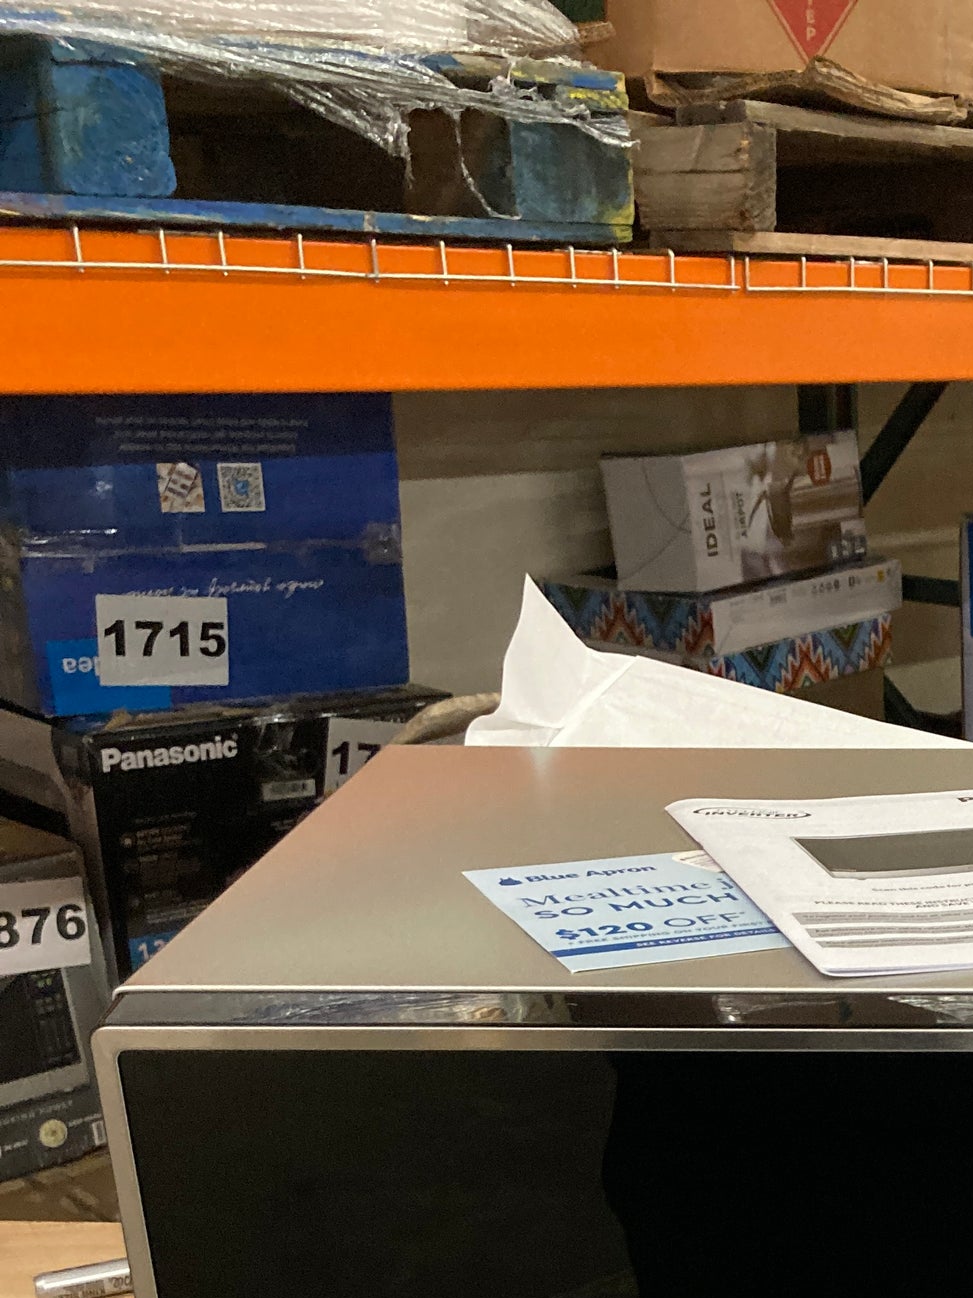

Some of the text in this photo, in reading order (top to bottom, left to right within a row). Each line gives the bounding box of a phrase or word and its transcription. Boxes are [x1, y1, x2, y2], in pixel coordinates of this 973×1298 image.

[701, 482, 719, 558] IDEAL
[103, 618, 227, 658] 1715
[100, 736, 239, 773] Panasonic
[525, 864, 658, 884] Blue Apron
[519, 877, 735, 908] Mealtime j
[533, 891, 739, 920] SO MUCH
[555, 920, 653, 941] $120
[658, 935, 706, 947] REVERSE
[708, 932, 731, 942] FOR
[734, 927, 775, 939] DETAILS
